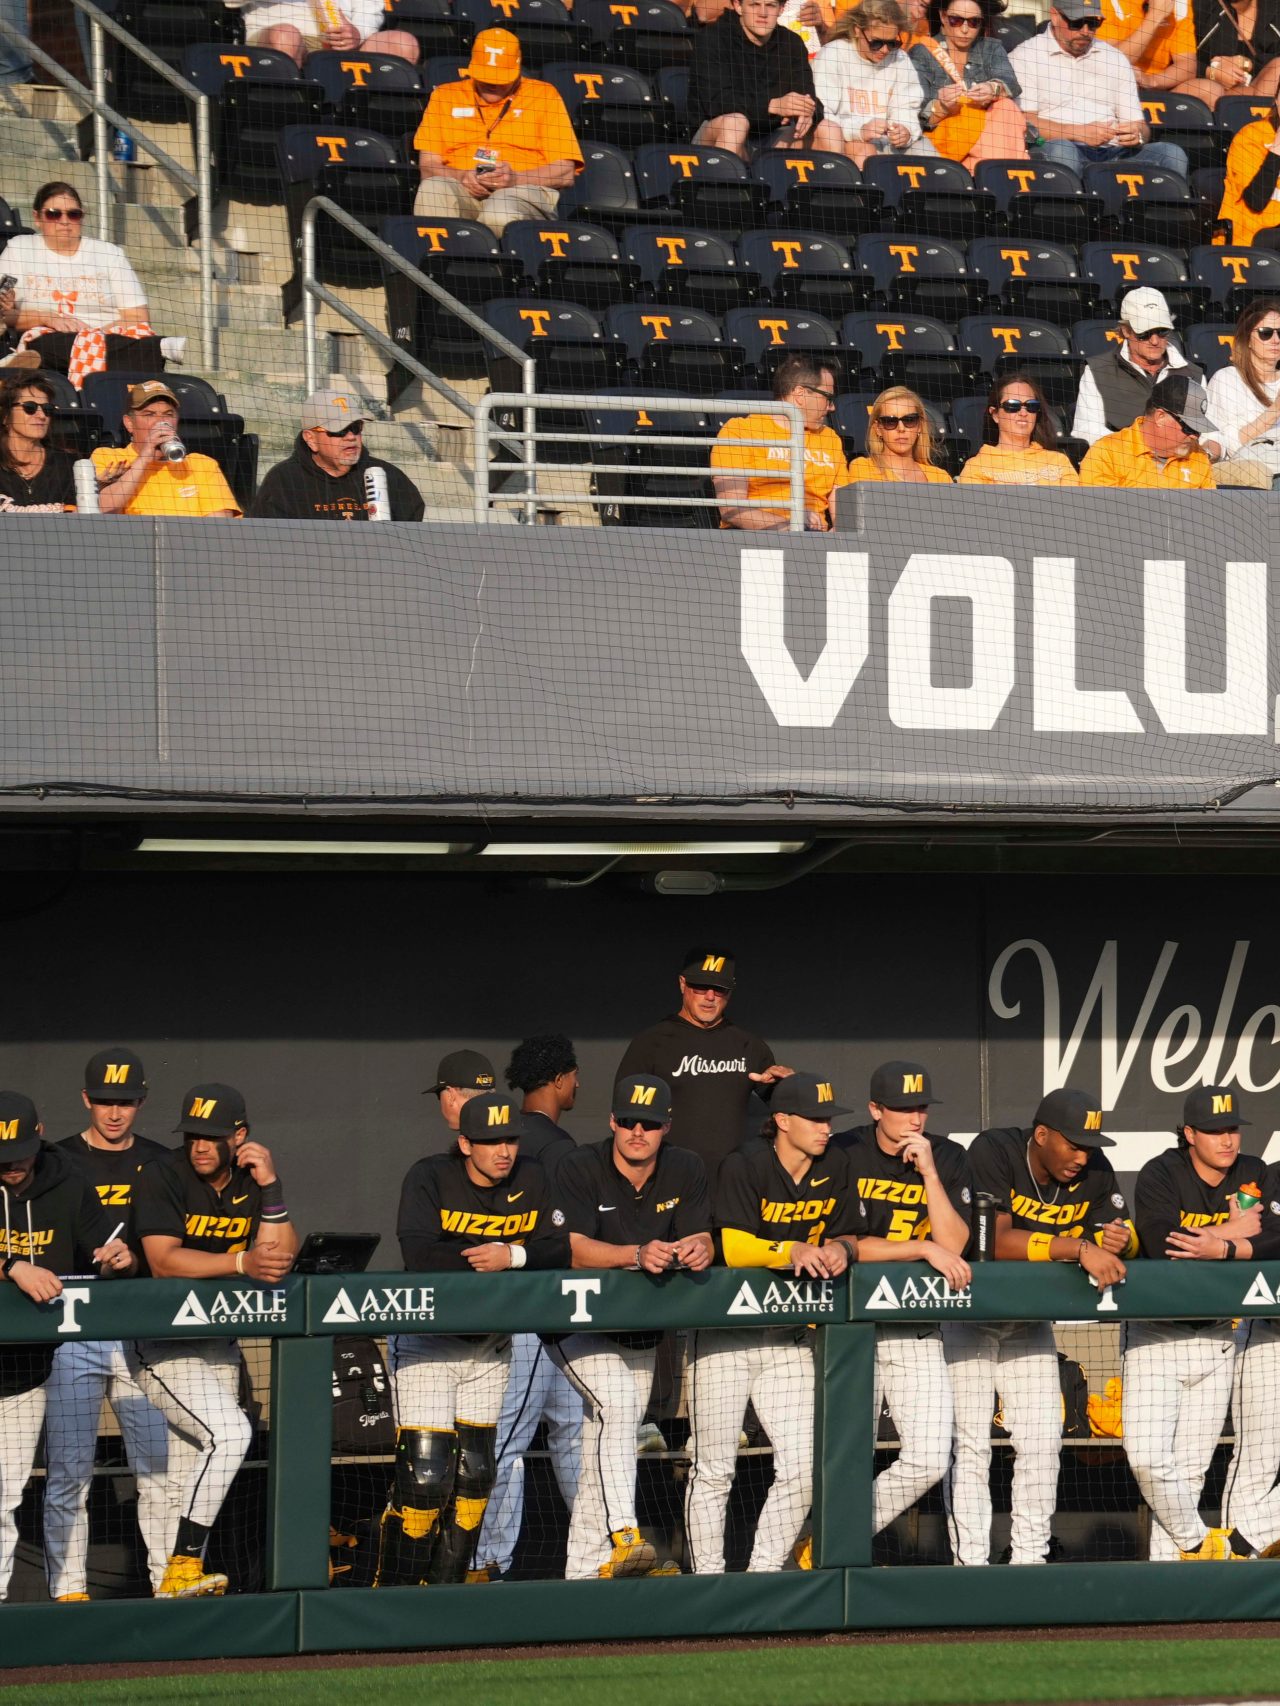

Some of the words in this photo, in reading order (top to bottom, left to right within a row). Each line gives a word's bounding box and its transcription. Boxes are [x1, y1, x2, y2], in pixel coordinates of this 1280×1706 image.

[610, 5, 638, 25] T
[220, 55, 250, 77] T
[484, 44, 504, 66] T
[341, 62, 371, 85] T
[574, 74, 603, 98] T
[316, 137, 347, 161] T
[670, 155, 699, 177] T
[786, 160, 814, 182] T
[897, 166, 926, 187] T
[1008, 170, 1035, 192] T
[1116, 174, 1144, 196] T
[417, 227, 448, 251] T
[540, 232, 569, 256] T
[656, 237, 686, 264] T
[772, 241, 801, 267] T
[889, 245, 918, 272] T
[1001, 250, 1029, 276] T
[1112, 254, 1140, 280] T
[1222, 257, 1249, 283] T
[520, 310, 550, 335] T
[641, 316, 671, 339] T
[759, 320, 788, 344] T
[876, 324, 905, 349] T
[992, 328, 1021, 352] T
[1180, 467, 1191, 482] T
[702, 955, 725, 972] M
[104, 1065, 129, 1083] M
[672, 1055, 746, 1076] Missouri
[816, 1083, 833, 1103] M
[904, 1075, 923, 1093] M
[631, 1088, 656, 1105] M
[1212, 1096, 1232, 1113] M
[190, 1097, 216, 1119] M
[488, 1107, 509, 1125] M
[1084, 1111, 1101, 1130] M
[760, 1197, 836, 1224] MIZZOU
[1008, 1185, 1089, 1227] MIZZOU
[441, 1209, 538, 1236] MIZZOU
[211, 1289, 287, 1313] AXLE
[360, 1287, 435, 1311] AXLE
[562, 1279, 600, 1322] T
[762, 1281, 834, 1303] AXLE
[50, 1288, 89, 1332] T
[763, 1304, 834, 1312] LOGISTICS
[902, 1300, 972, 1308] LOGISTICS
[211, 1315, 287, 1323] LOGISTICS
[360, 1312, 435, 1321] LOGISTICS
